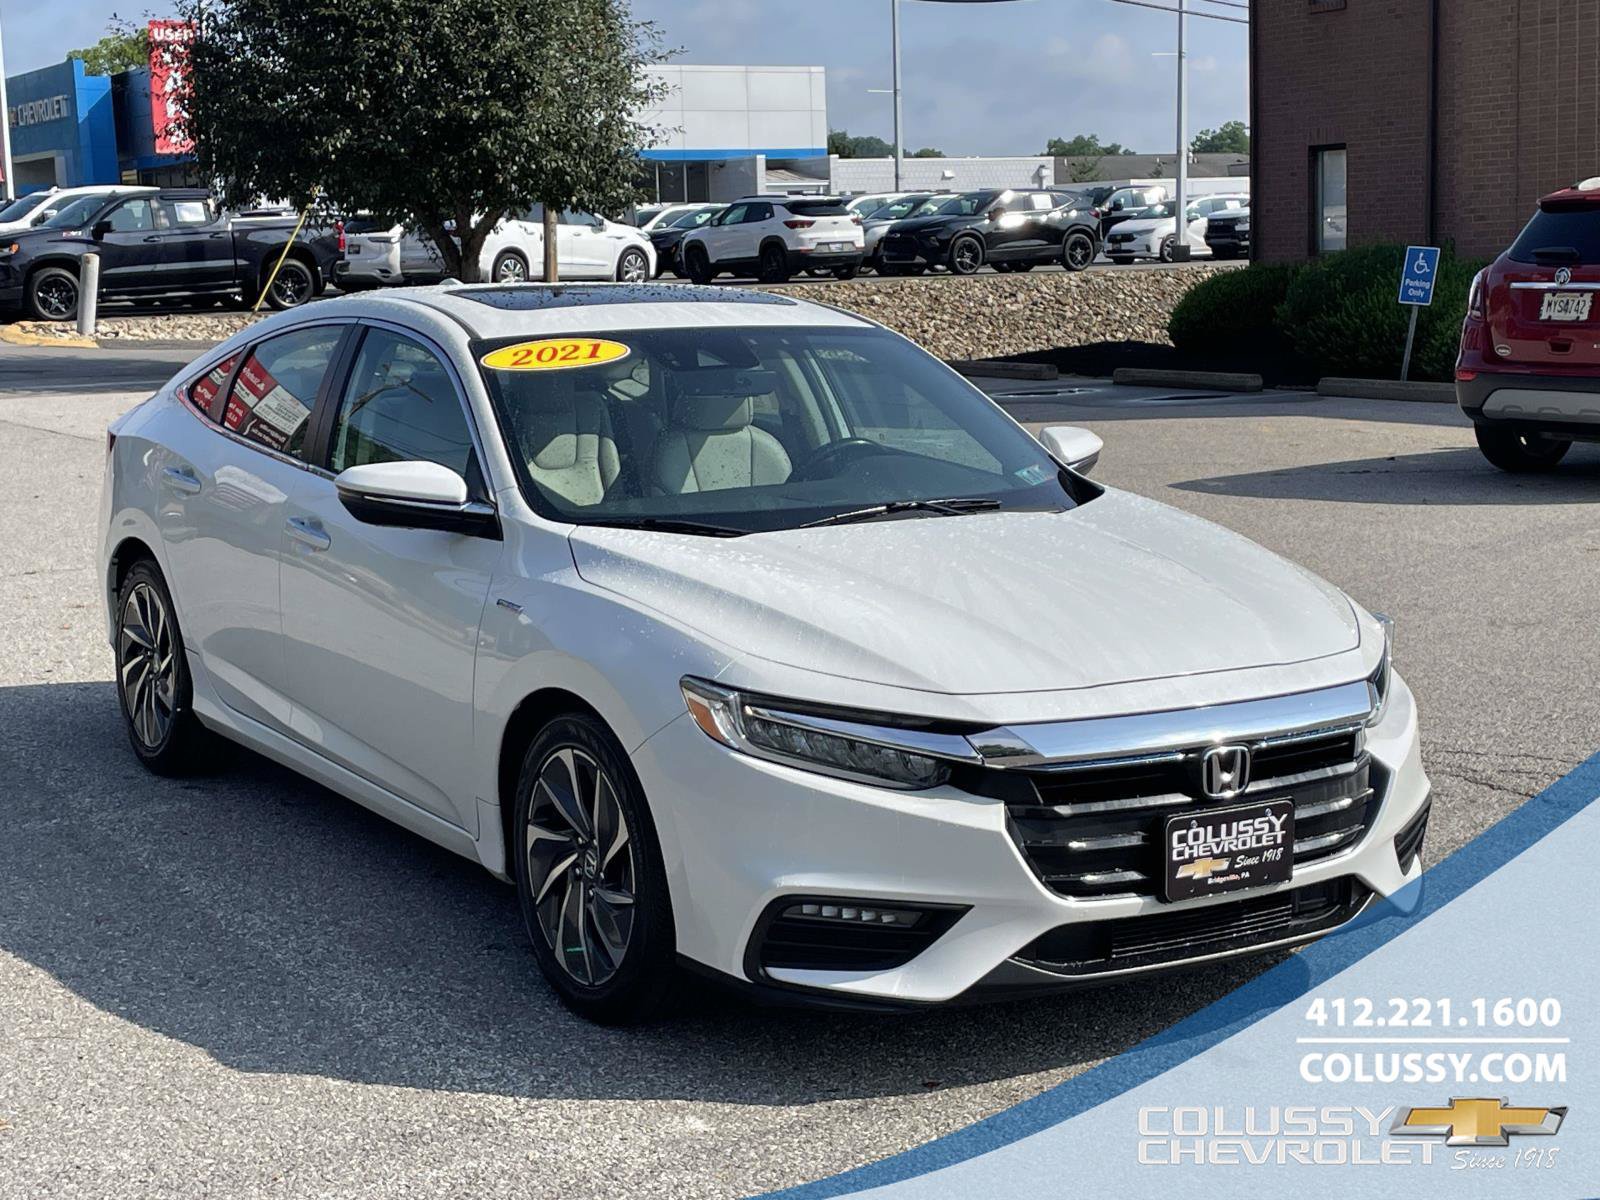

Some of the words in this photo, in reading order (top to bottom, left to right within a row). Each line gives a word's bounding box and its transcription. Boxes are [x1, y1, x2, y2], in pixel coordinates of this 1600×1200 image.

[18, 94, 68, 126] CHEVROLET
[1405, 278, 1431, 290] Parking
[1408, 288, 1425, 298] Only
[510, 343, 602, 366] 2021
[1172, 813, 1289, 849] COLUSSY
[1172, 830, 1287, 861] CHEVROLET
[1234, 854, 1260, 869] Since
[1261, 847, 1284, 863] 1918
